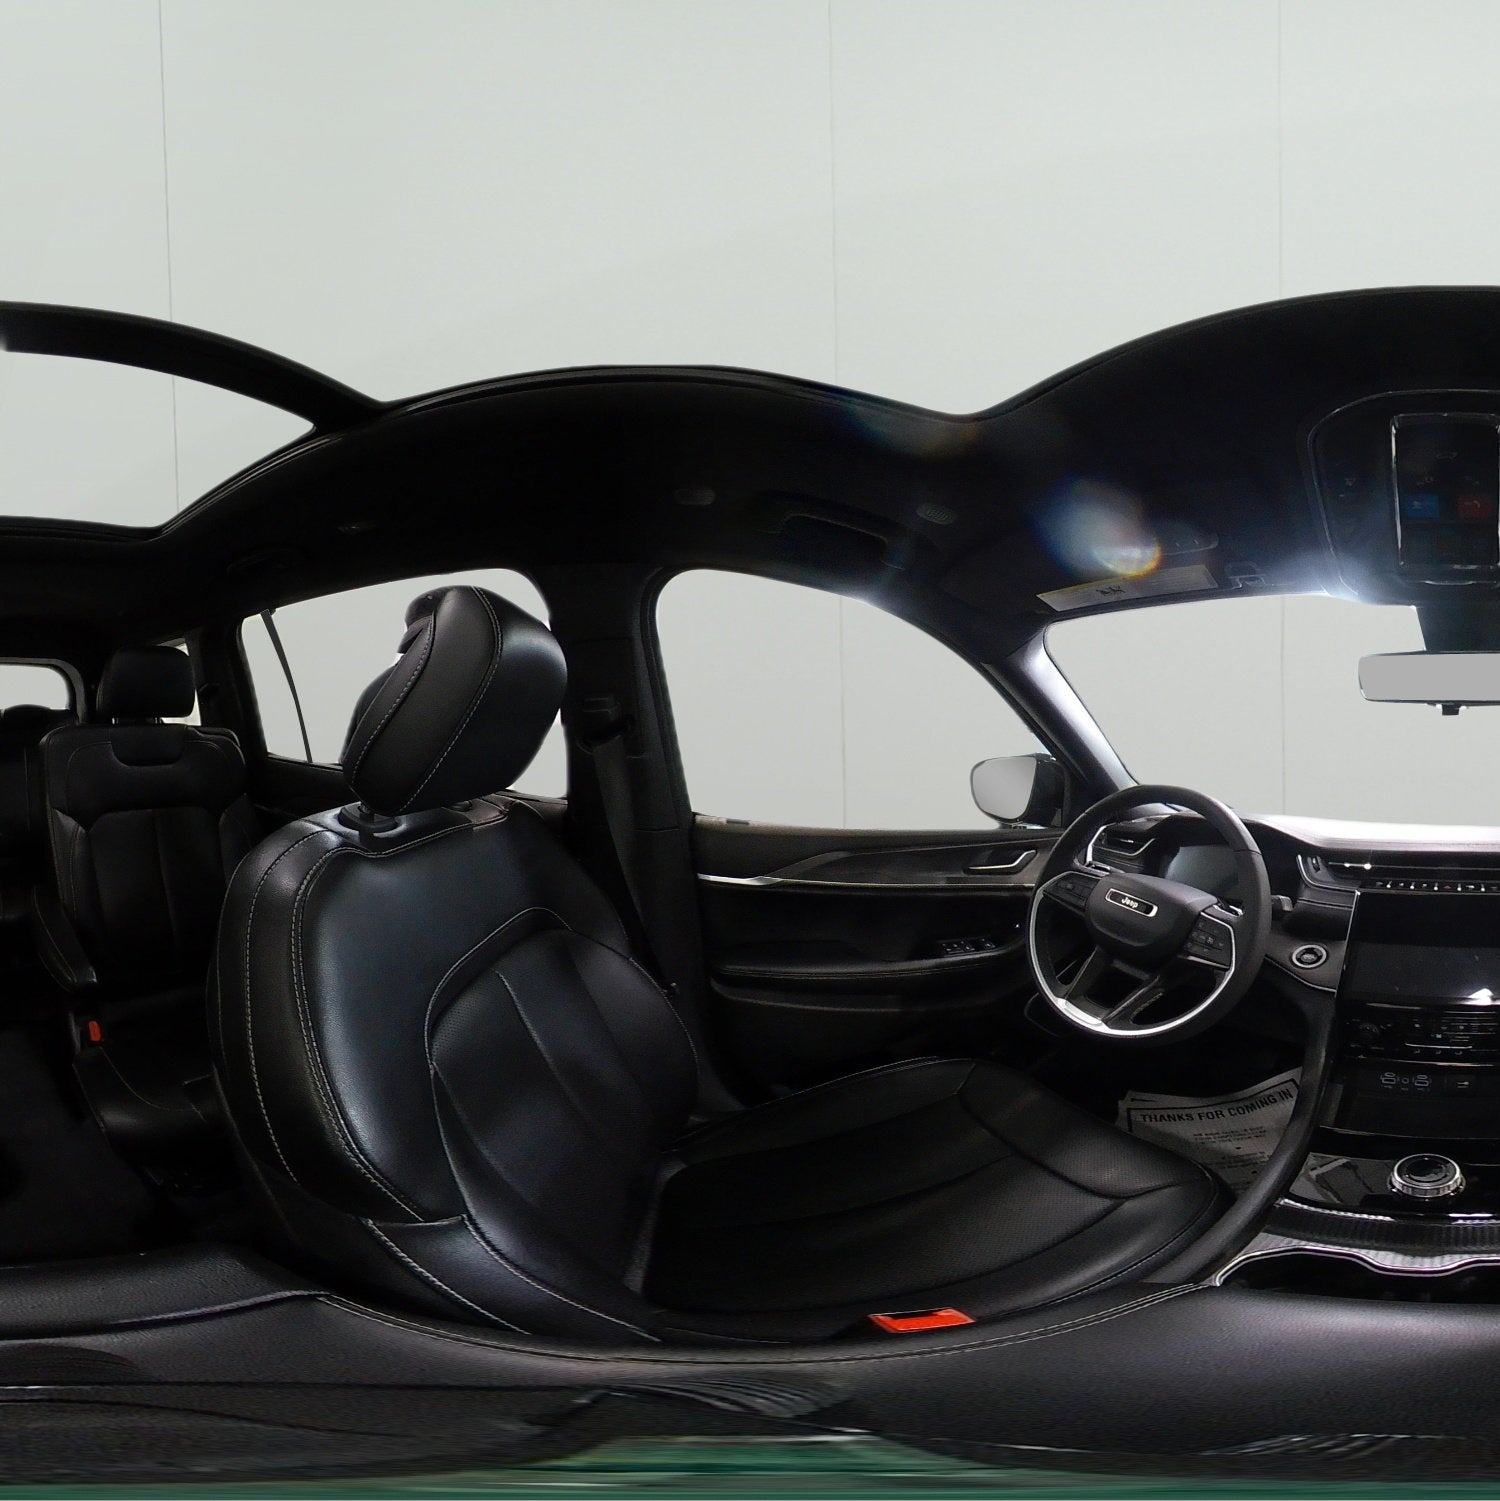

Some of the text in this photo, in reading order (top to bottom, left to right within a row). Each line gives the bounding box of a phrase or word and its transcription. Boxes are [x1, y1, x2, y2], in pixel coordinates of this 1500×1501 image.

[1121, 897, 1139, 909] Jeep
[1140, 1088, 1294, 1123] THANKS FOR COMING IN
